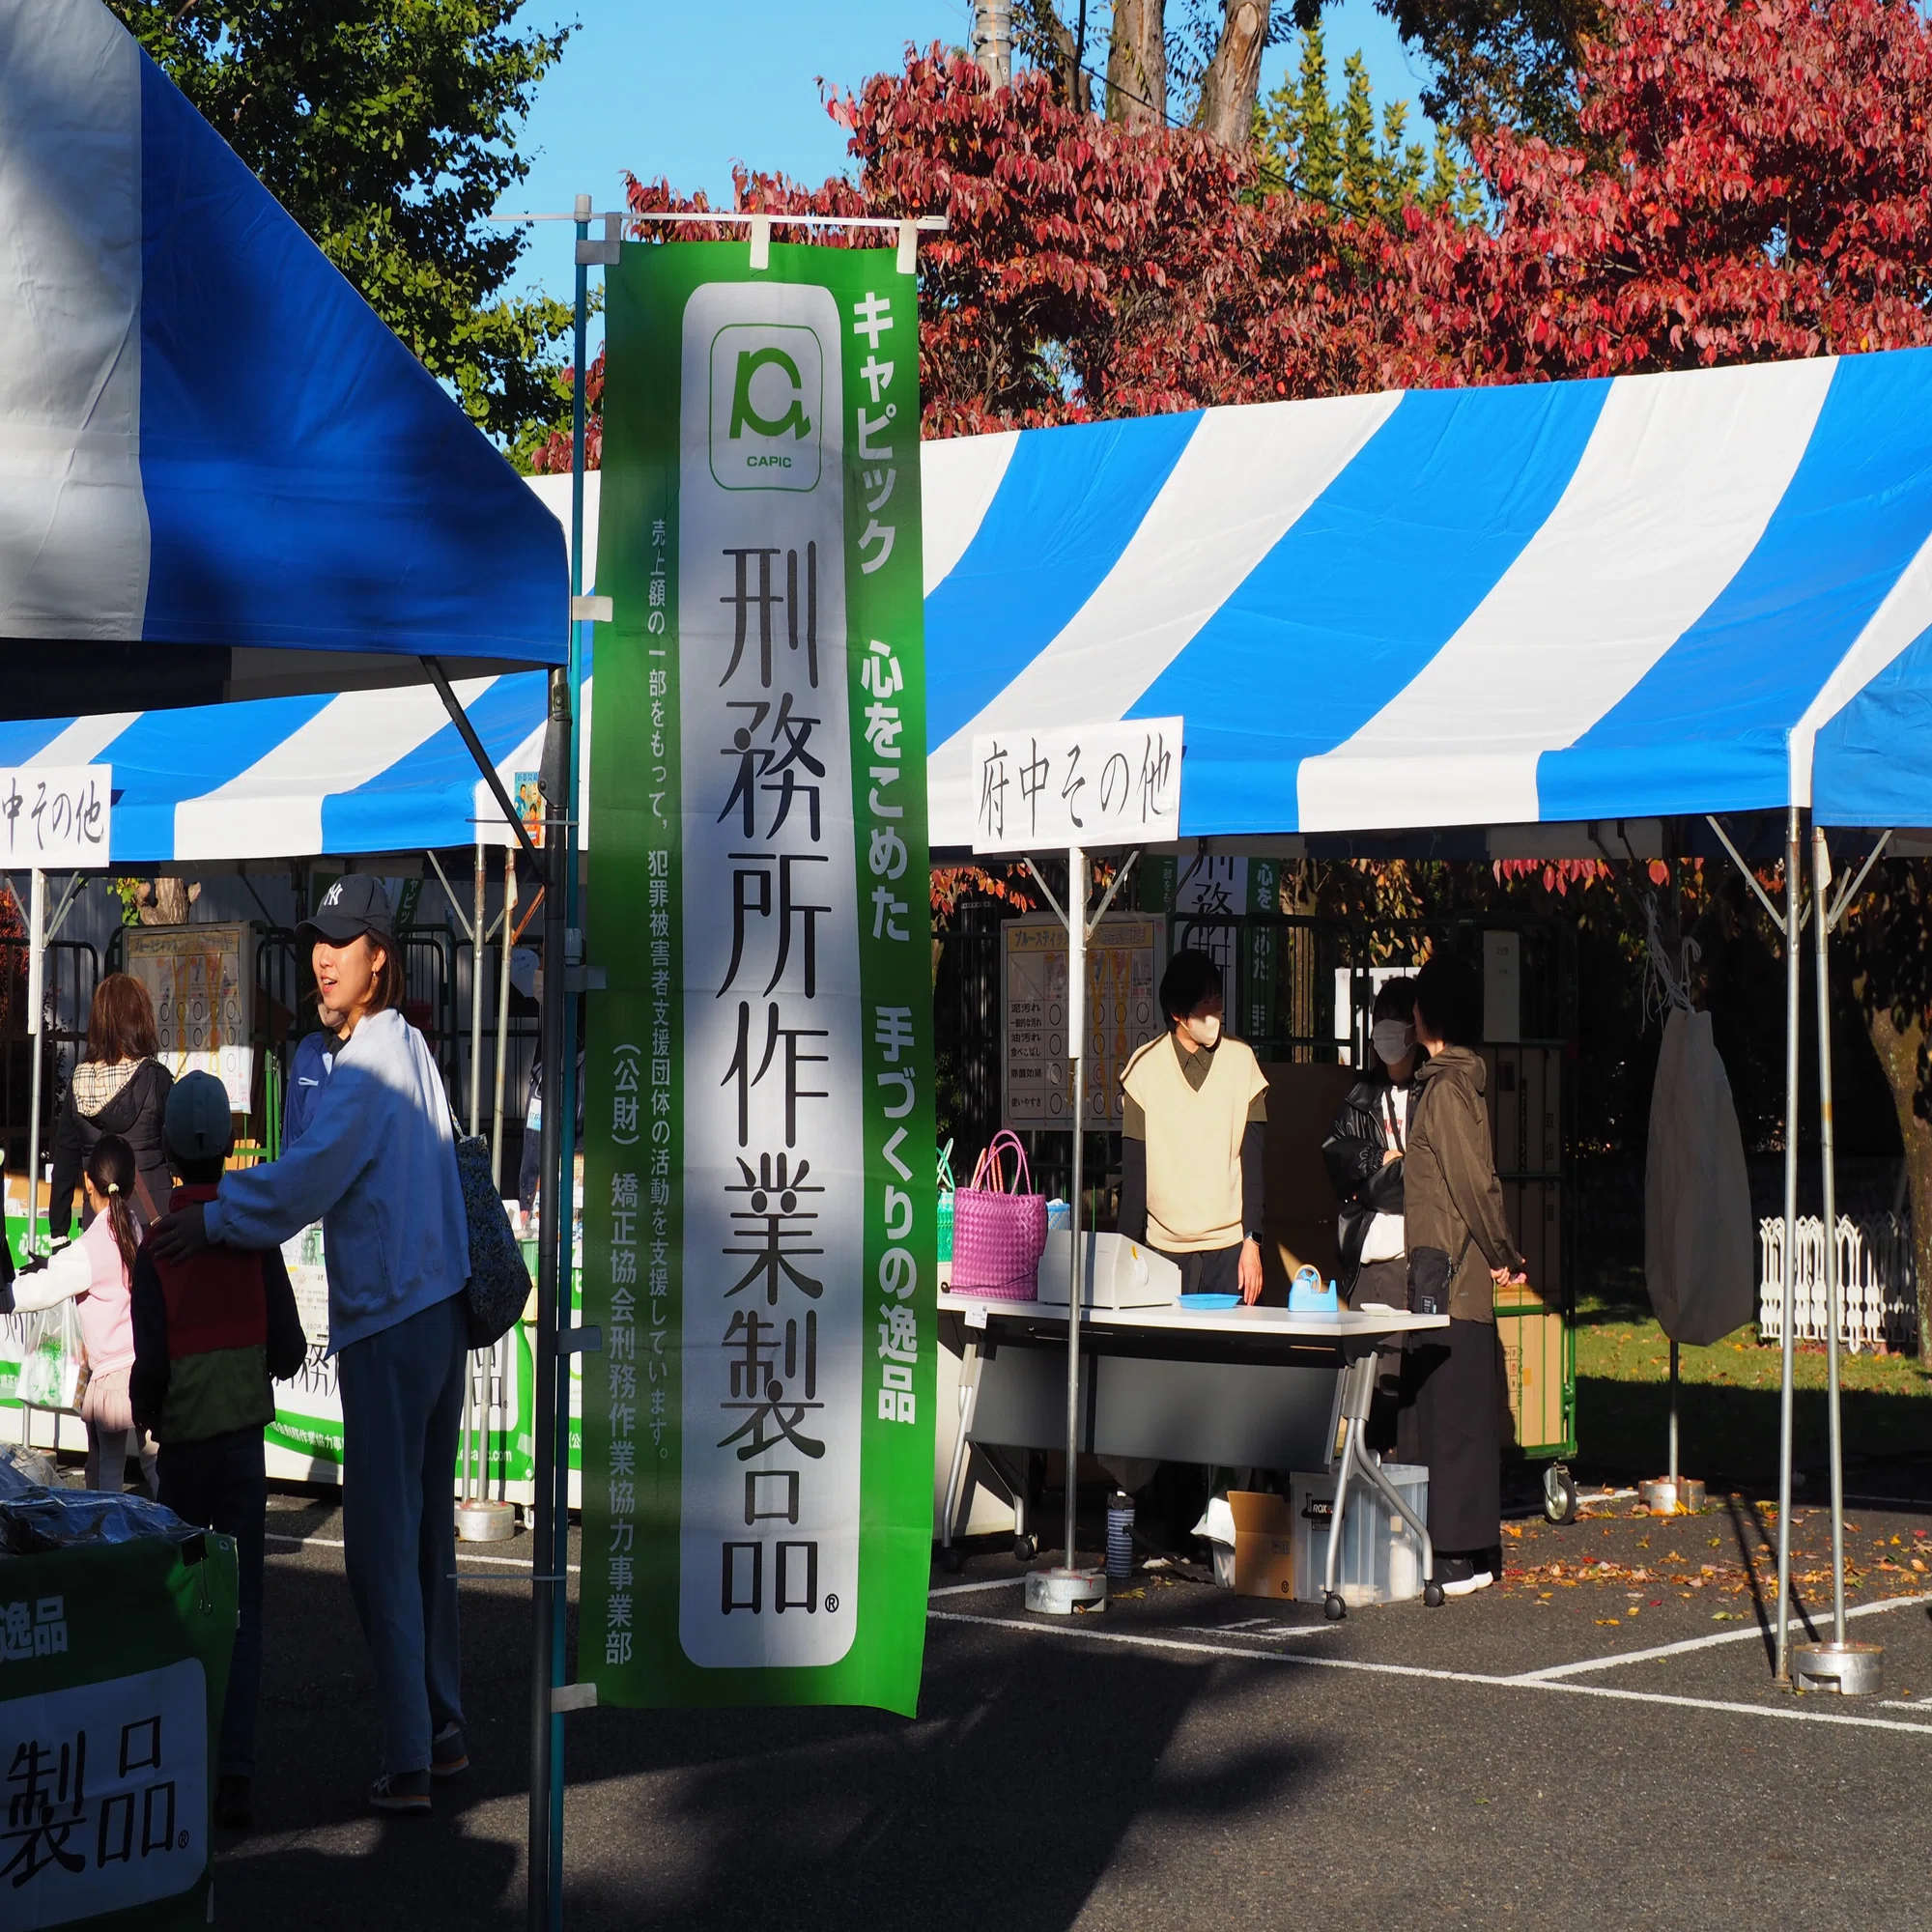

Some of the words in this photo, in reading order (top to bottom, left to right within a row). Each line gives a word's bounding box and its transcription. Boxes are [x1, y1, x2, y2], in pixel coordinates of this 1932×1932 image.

[746, 456, 792, 469] CAPIC
[853, 292, 897, 575] キャピック
[2, 777, 104, 854] 中その他
[861, 639, 910, 942] 心をこめた
[979, 732, 1173, 840] 府中その他
[324, 883, 343, 906] NY
[1010, 1033, 1041, 1043] 油汚れ
[874, 1006, 918, 1426] 手づくりの逸品
